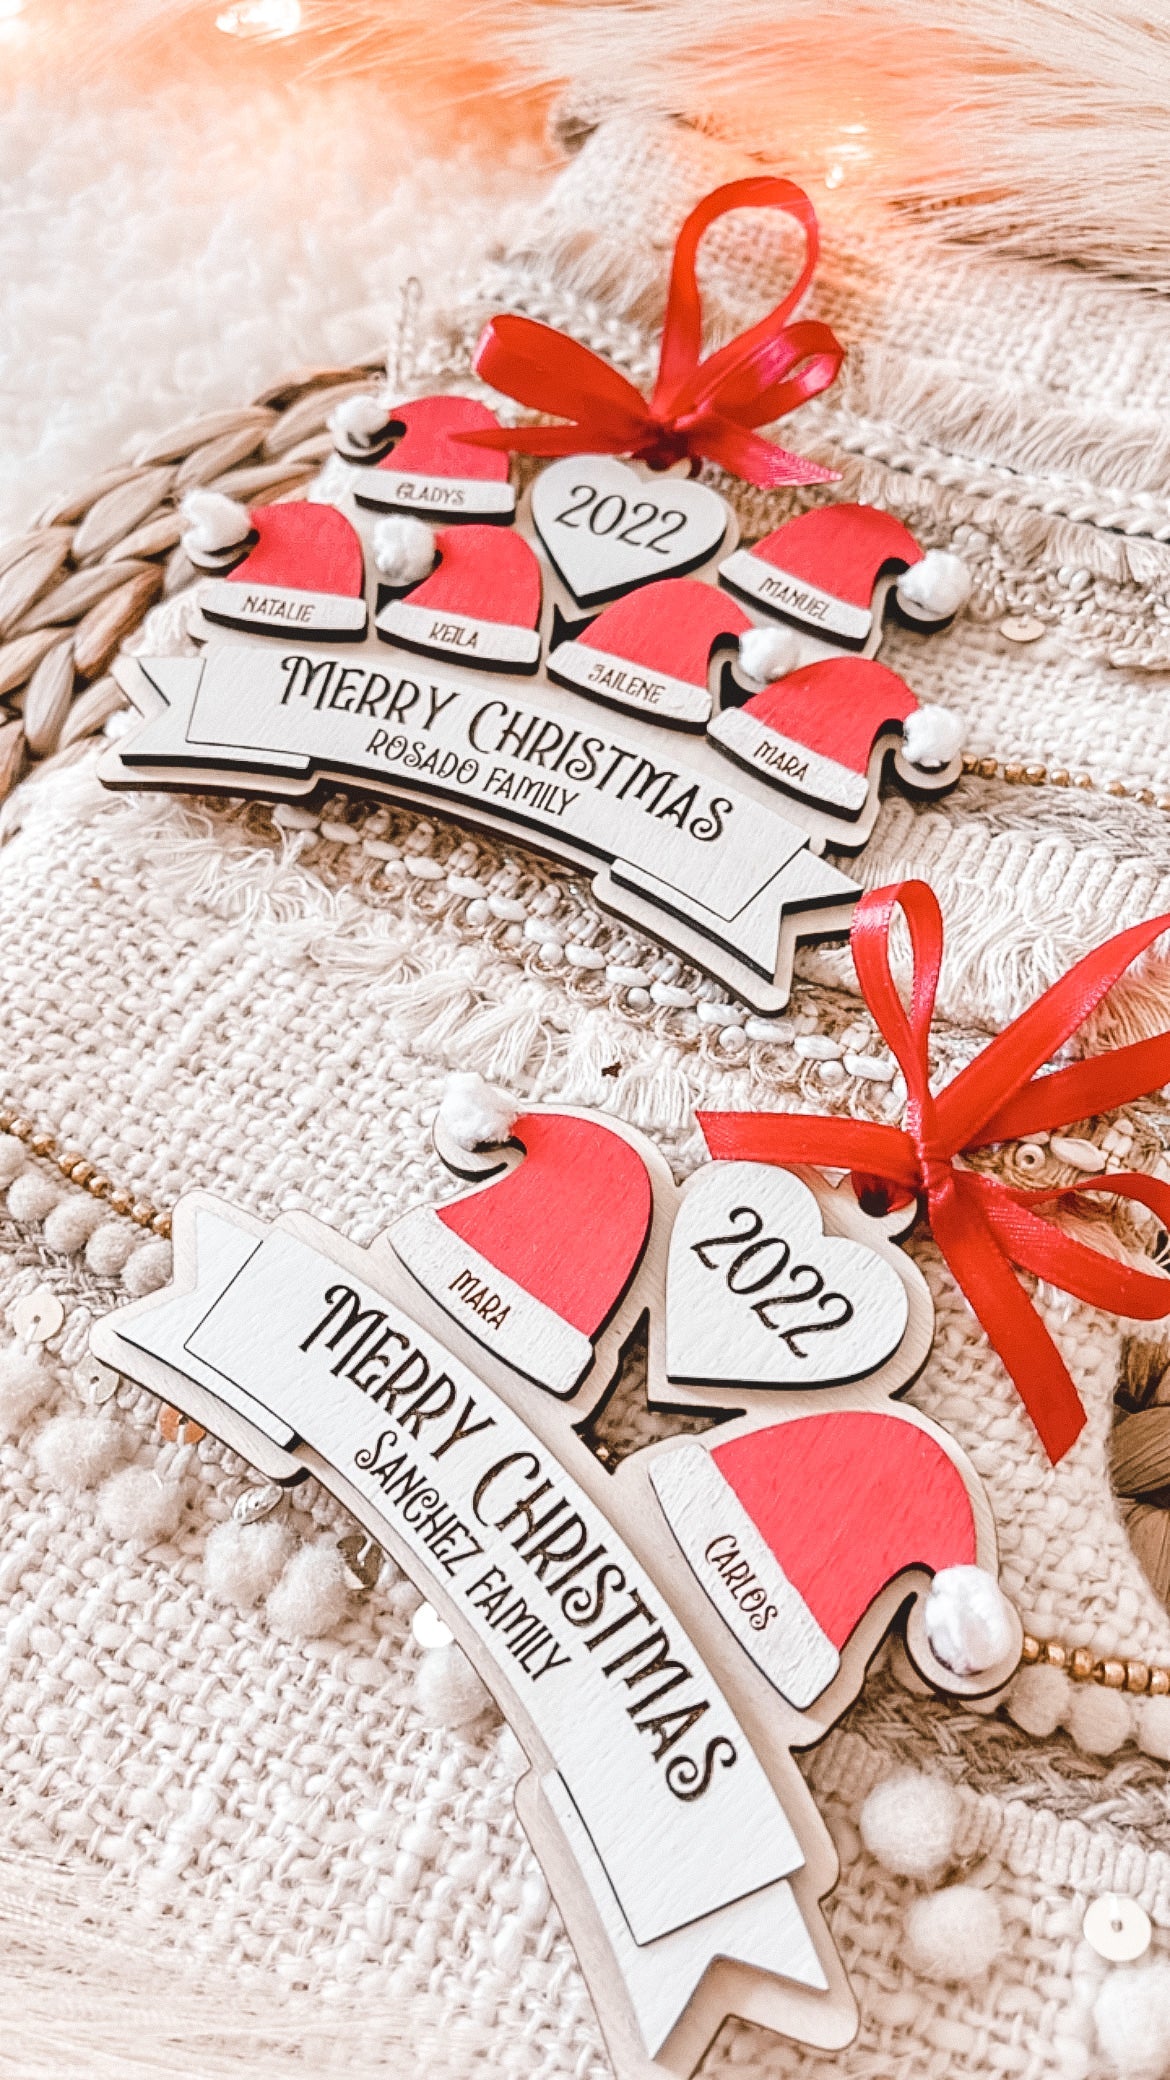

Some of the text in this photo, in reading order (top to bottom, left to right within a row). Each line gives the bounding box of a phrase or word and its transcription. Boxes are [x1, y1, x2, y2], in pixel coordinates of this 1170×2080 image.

[395, 483, 465, 506] GLADYS
[555, 485, 687, 554] 2022
[242, 595, 315, 622] NATALIE
[759, 575, 830, 621] MANUEL
[430, 621, 478, 649] KEILA
[587, 664, 665, 704] JAILENE
[280, 656, 734, 841] MERRY CHRISTMAS
[365, 728, 579, 816] ROSADO FAMILY
[754, 739, 808, 781] MARA
[448, 1269, 510, 1332] MARA
[691, 1207, 855, 1358] 2022
[299, 1285, 736, 1802] MERRY CHRISTMAS
[353, 1430, 573, 1682] SANCHEZ FAMILY
[705, 1535, 778, 1632] CARLOS
